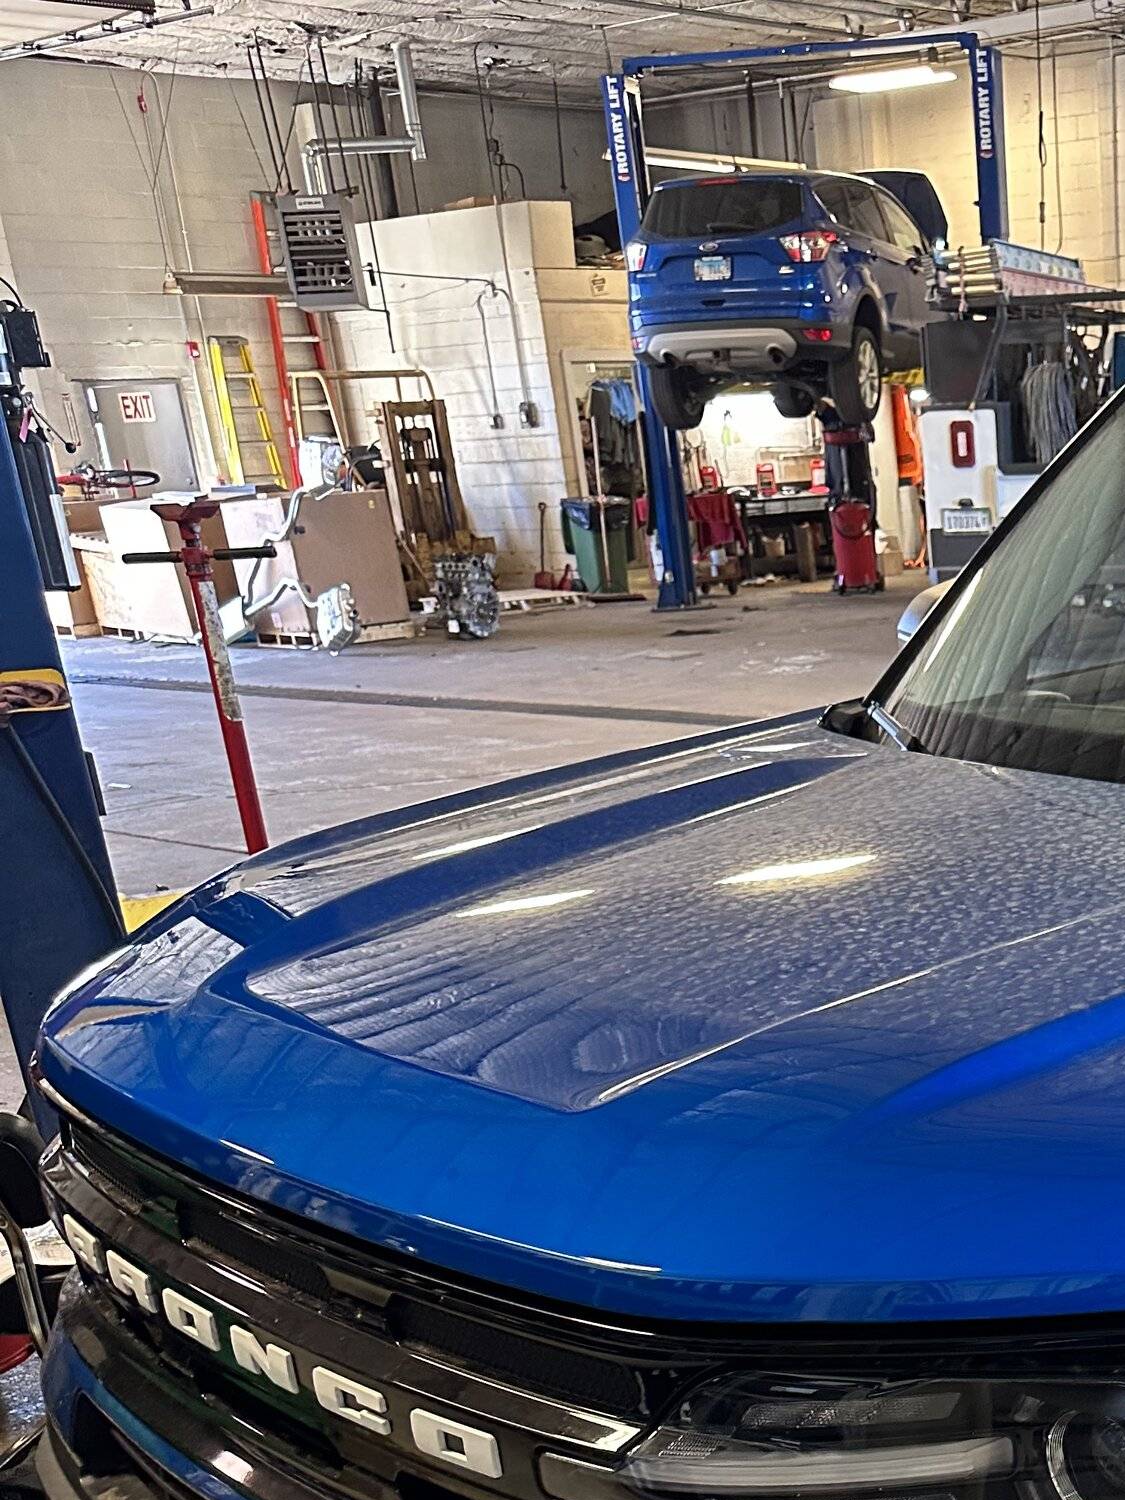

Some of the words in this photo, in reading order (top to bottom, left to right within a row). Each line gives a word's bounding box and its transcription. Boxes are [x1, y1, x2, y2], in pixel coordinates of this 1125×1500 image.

[976, 48, 988, 82] LIFT
[606, 76, 620, 109] LIFT
[978, 87, 993, 150] ROTARY
[611, 112, 629, 174] ROTARY
[121, 395, 151, 419] EXIT
[63, 1214, 503, 1478] BRONCO
